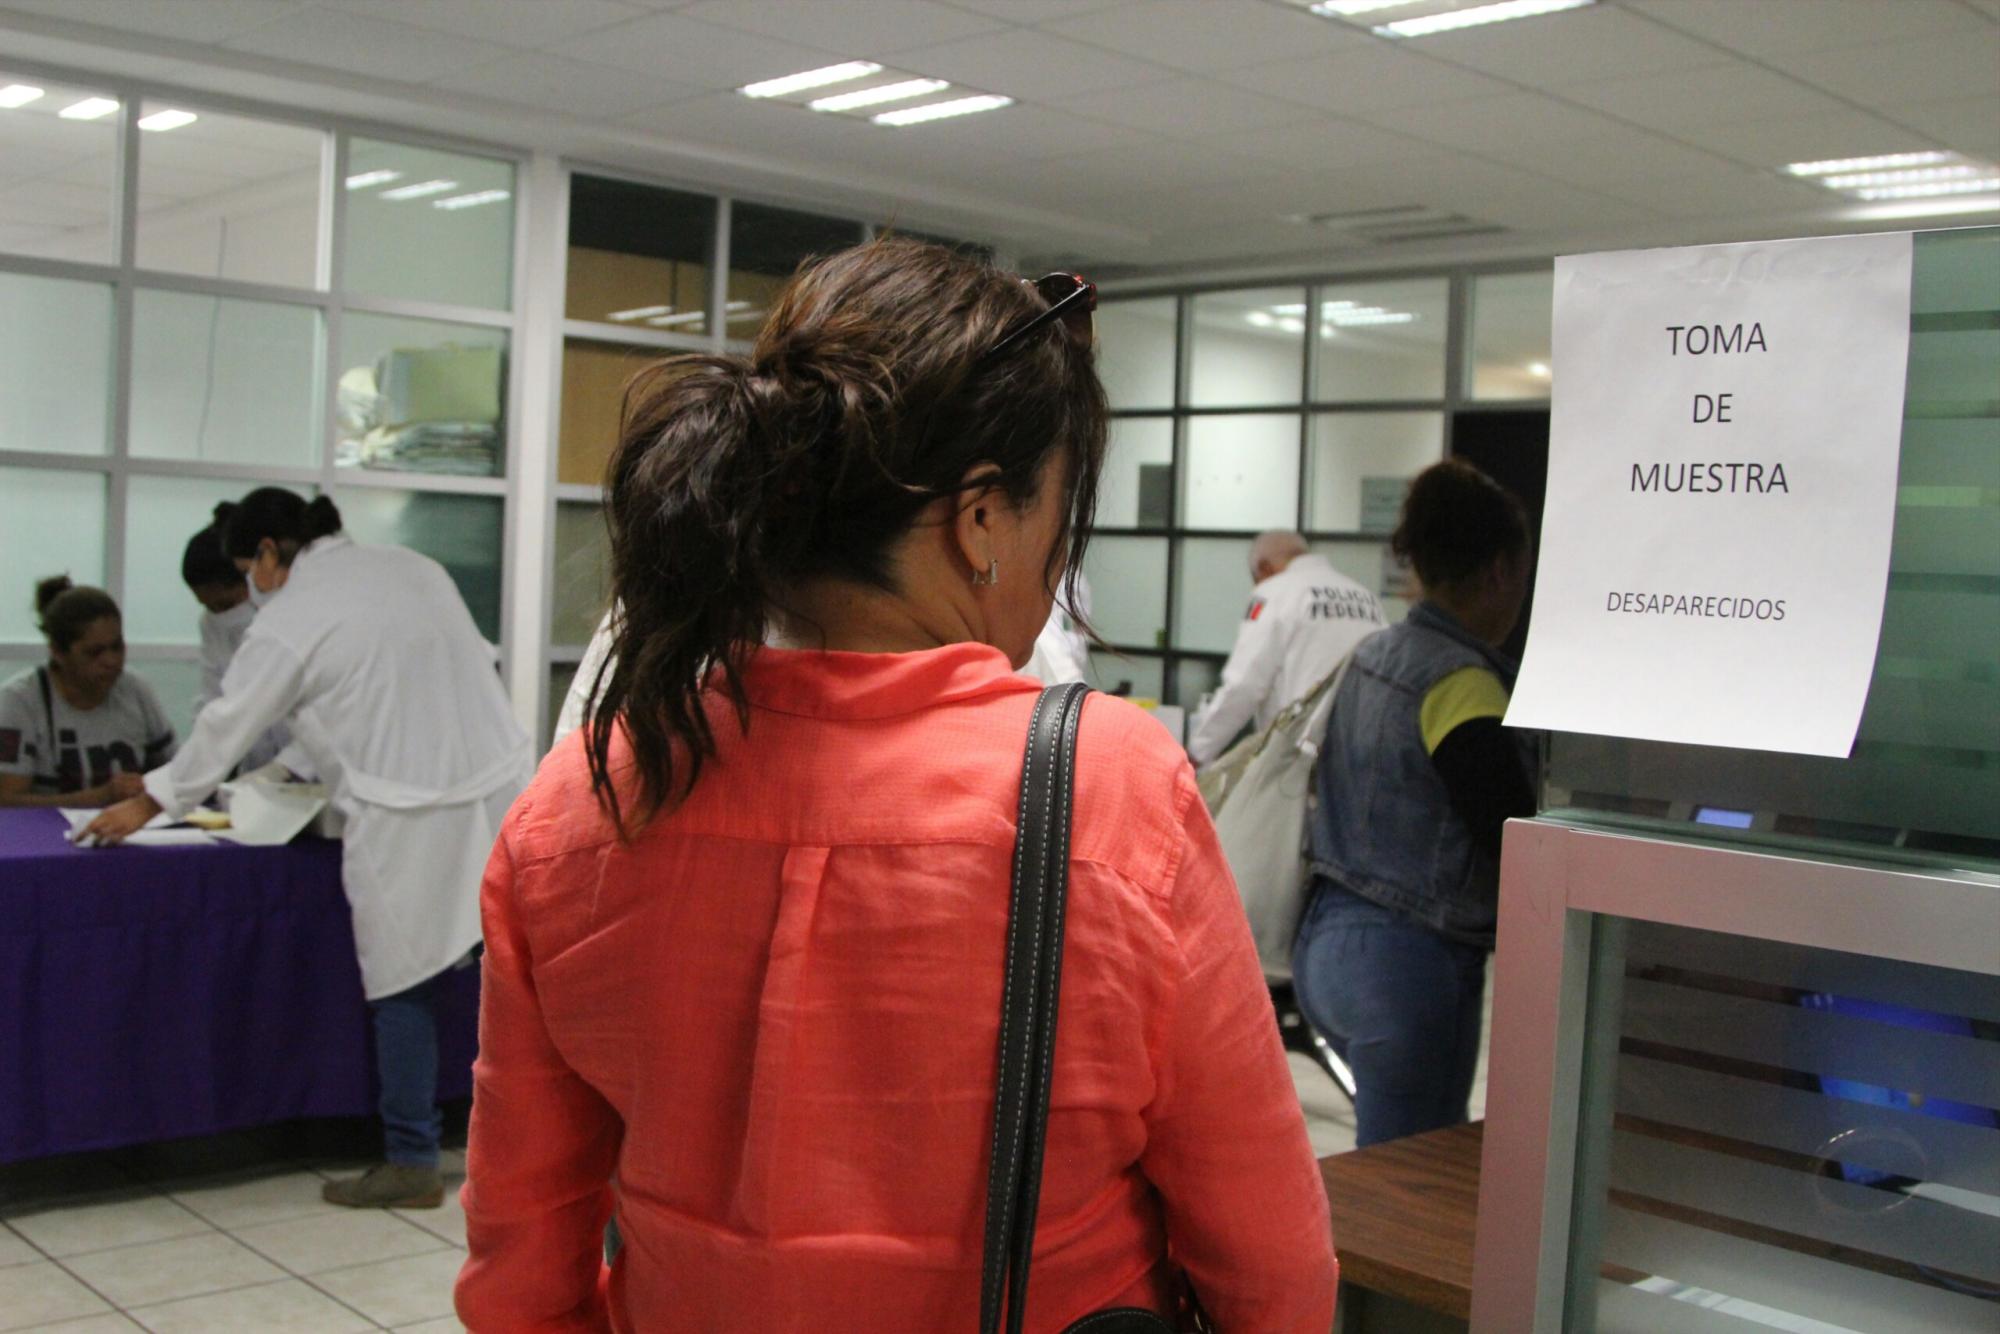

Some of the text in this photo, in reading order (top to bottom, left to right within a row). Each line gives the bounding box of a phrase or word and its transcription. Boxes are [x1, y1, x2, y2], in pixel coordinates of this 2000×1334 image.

[1666, 322, 1767, 355] TOMA
[1692, 393, 1733, 423] DE
[1631, 463, 1789, 493] MUESTRA
[1606, 592, 1786, 620] DESAPARECIDOS
